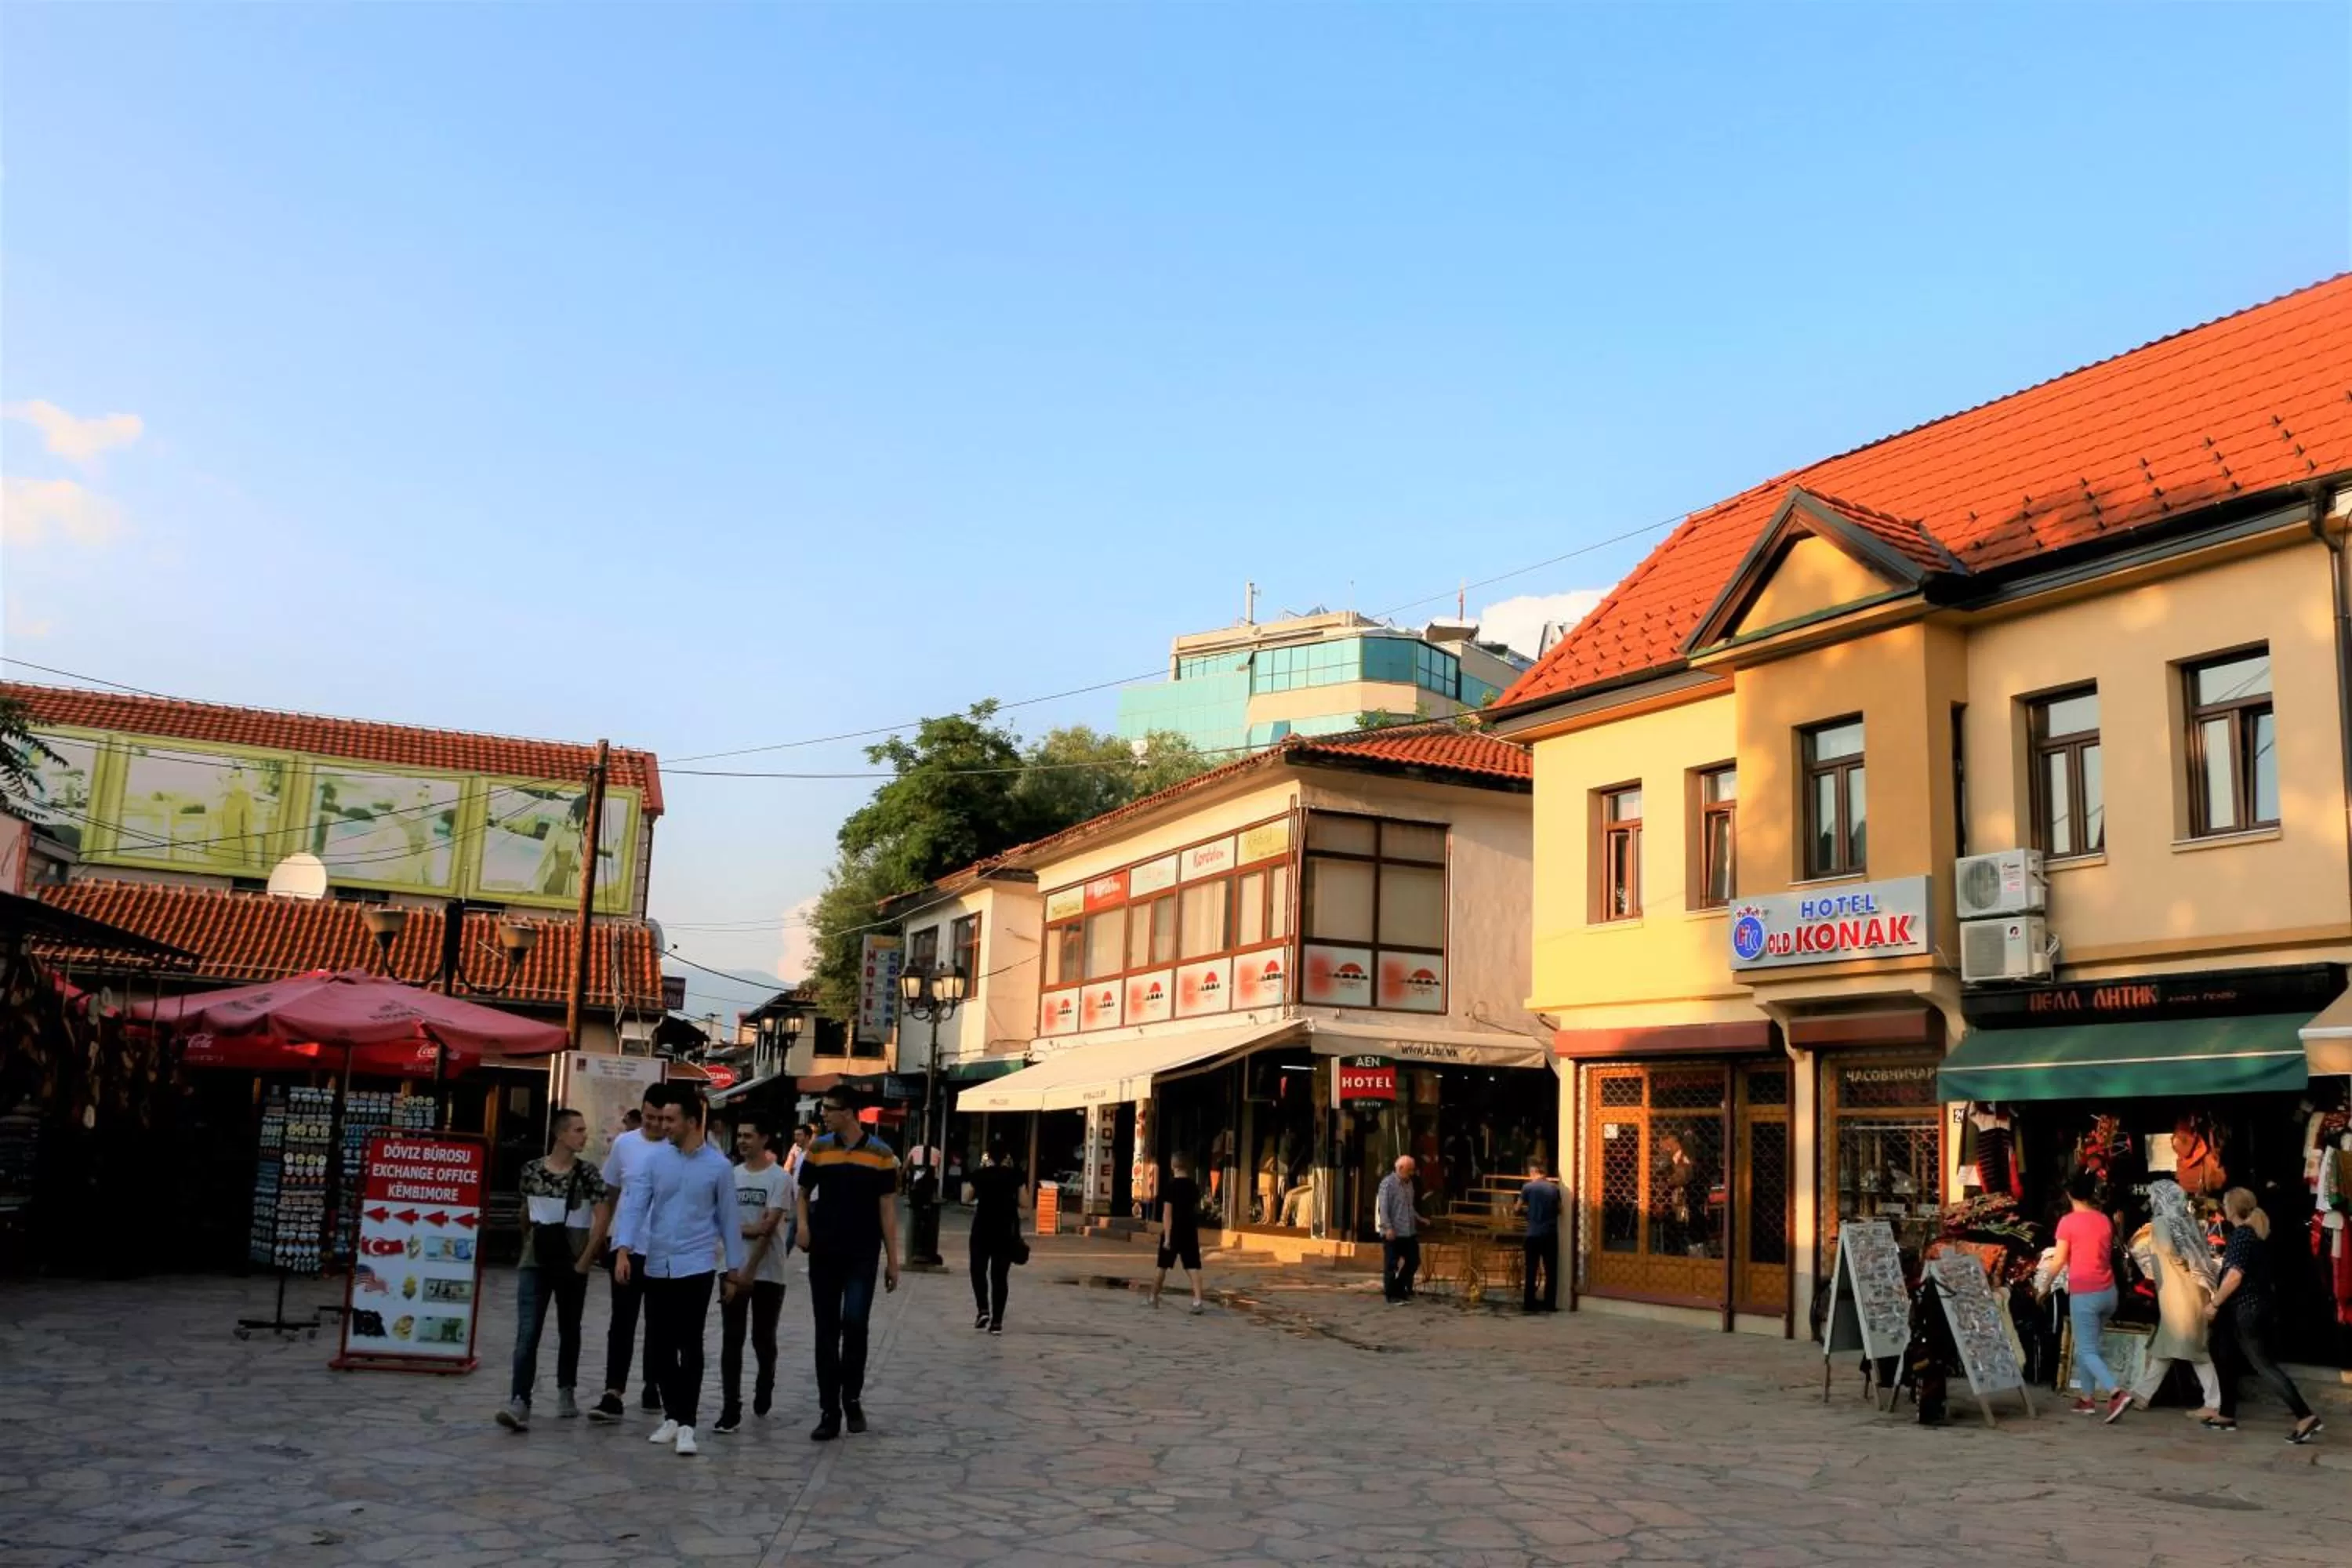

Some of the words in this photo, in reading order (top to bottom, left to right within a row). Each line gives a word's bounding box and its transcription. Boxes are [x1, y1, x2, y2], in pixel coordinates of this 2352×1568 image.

[1800, 894, 1875, 918] HOTEL
[1768, 932, 1791, 953] OLD
[1795, 915, 1911, 953] KONAK
[864, 949, 877, 1025] HOTEL
[1356, 1056, 1381, 1067] AEN
[1341, 1076, 1393, 1088] HOTEL
[383, 1142, 420, 1160] DÖVIZ
[422, 1145, 471, 1163] BÜROSU
[1100, 1108, 1114, 1196] HOTEL
[372, 1163, 434, 1181] EXCHANGE
[436, 1168, 478, 1184] OFFICE
[387, 1181, 459, 1202] KËMBIMORE
